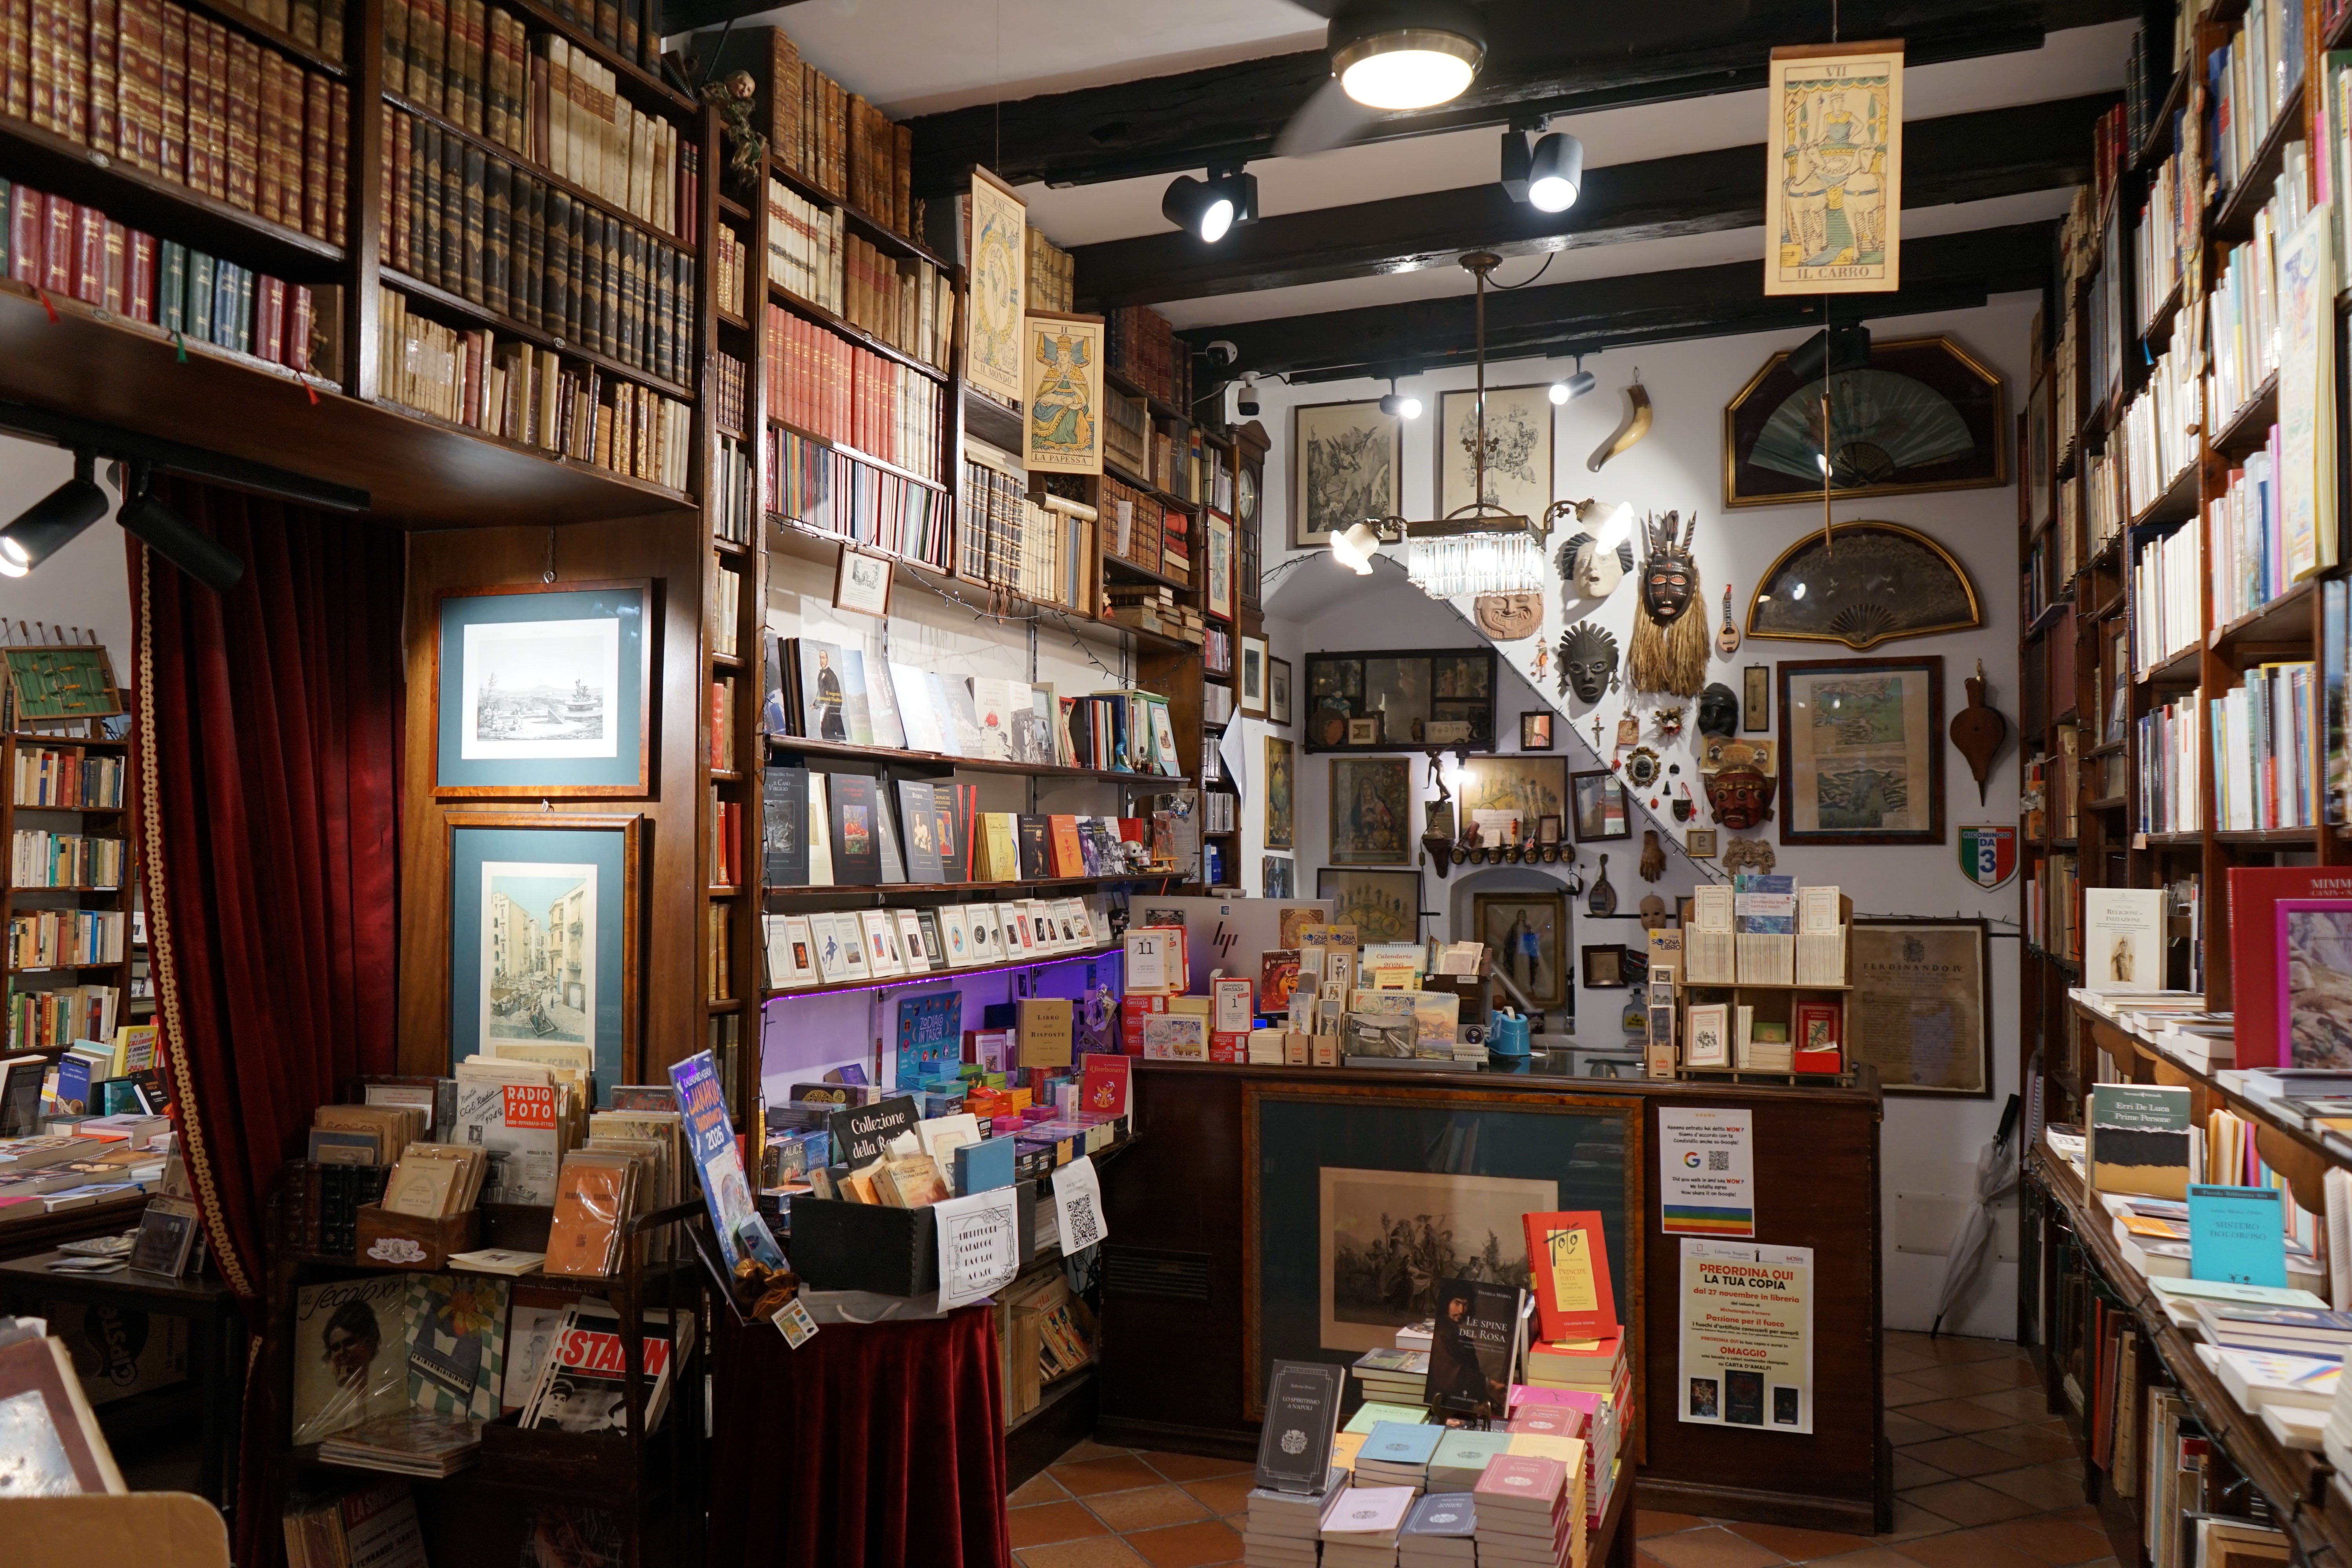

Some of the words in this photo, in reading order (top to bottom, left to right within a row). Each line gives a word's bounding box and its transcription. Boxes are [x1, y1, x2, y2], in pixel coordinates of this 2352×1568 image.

[1827, 65, 1847, 77] VII
[993, 197, 1005, 212] XXI
[1797, 269, 1813, 279] IL
[1818, 266, 1870, 279] CARRO
[980, 363, 987, 372] IL
[989, 367, 1012, 385] MONDO
[1034, 453, 1046, 462] LA
[1049, 454, 1087, 465] PAPESSA
[1980, 849, 1996, 873] 3
[1864, 963, 1949, 971] FERDINANDO
[918, 1030, 925, 1044] IN
[926, 1026, 942, 1042] TASCA
[477, 1089, 495, 1107] Radio
[507, 1087, 550, 1102] RADIO
[509, 1102, 551, 1118] FOTO
[2135, 1103, 2147, 1111] De
[2149, 1104, 2170, 1112] Luca
[485, 1107, 504, 1125] 1942
[851, 1112, 906, 1135] Collezione
[2115, 1113, 2139, 1121] Prime
[2140, 1114, 2171, 1123] Persone
[706, 1125, 724, 1151] 2026
[784, 1143, 803, 1157] ALICE
[853, 1140, 877, 1159] della
[959, 1230, 976, 1241] LIBRI
[977, 1225, 997, 1236] FUORI
[2216, 1221, 2260, 1230] MISTERO
[2209, 1230, 2267, 1240] DOLOROSO
[960, 1238, 994, 1254] CATALOGO
[965, 1258, 974, 1267] DA
[1700, 1263, 1769, 1278] PREORDINA
[1772, 1270, 1794, 1281] QUI
[1704, 1274, 1719, 1284] LA
[1722, 1276, 1745, 1287] TUA
[1748, 1278, 1786, 1290] COPIA
[1719, 1290, 1759, 1299] novembre
[1770, 1294, 1800, 1303] libreria
[1466, 1316, 1479, 1327] LE
[1480, 1320, 1508, 1332] SPINE
[1706, 1314, 1740, 1323] Passione
[1763, 1319, 1785, 1328] fuoco
[1459, 1328, 1477, 1338] DEL
[1480, 1329, 1506, 1343] ROSA
[1720, 1346, 1767, 1358] OMAGGIO
[1290, 1397, 1320, 1405] SPIRITISMO
